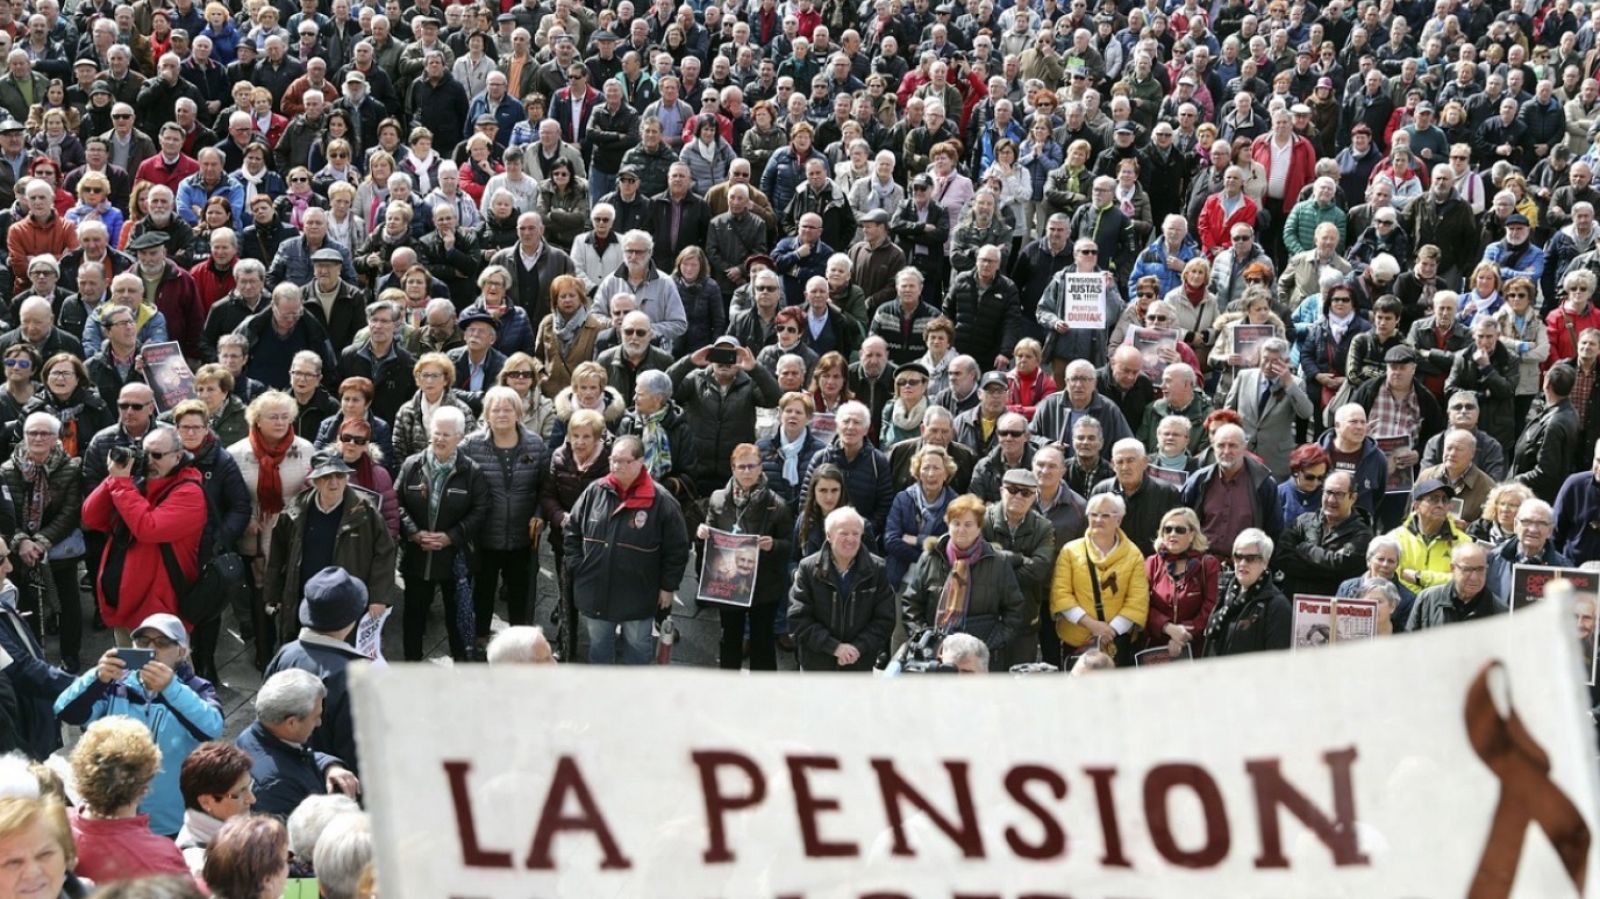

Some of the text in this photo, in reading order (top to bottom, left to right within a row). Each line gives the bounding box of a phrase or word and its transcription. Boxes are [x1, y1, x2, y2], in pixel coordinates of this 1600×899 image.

[1068, 284, 1102, 293] JUSTAS
[1068, 313, 1102, 321] DUINAK
[1299, 602, 1319, 613] Por
[442, 745, 1371, 870] LA PENSION
